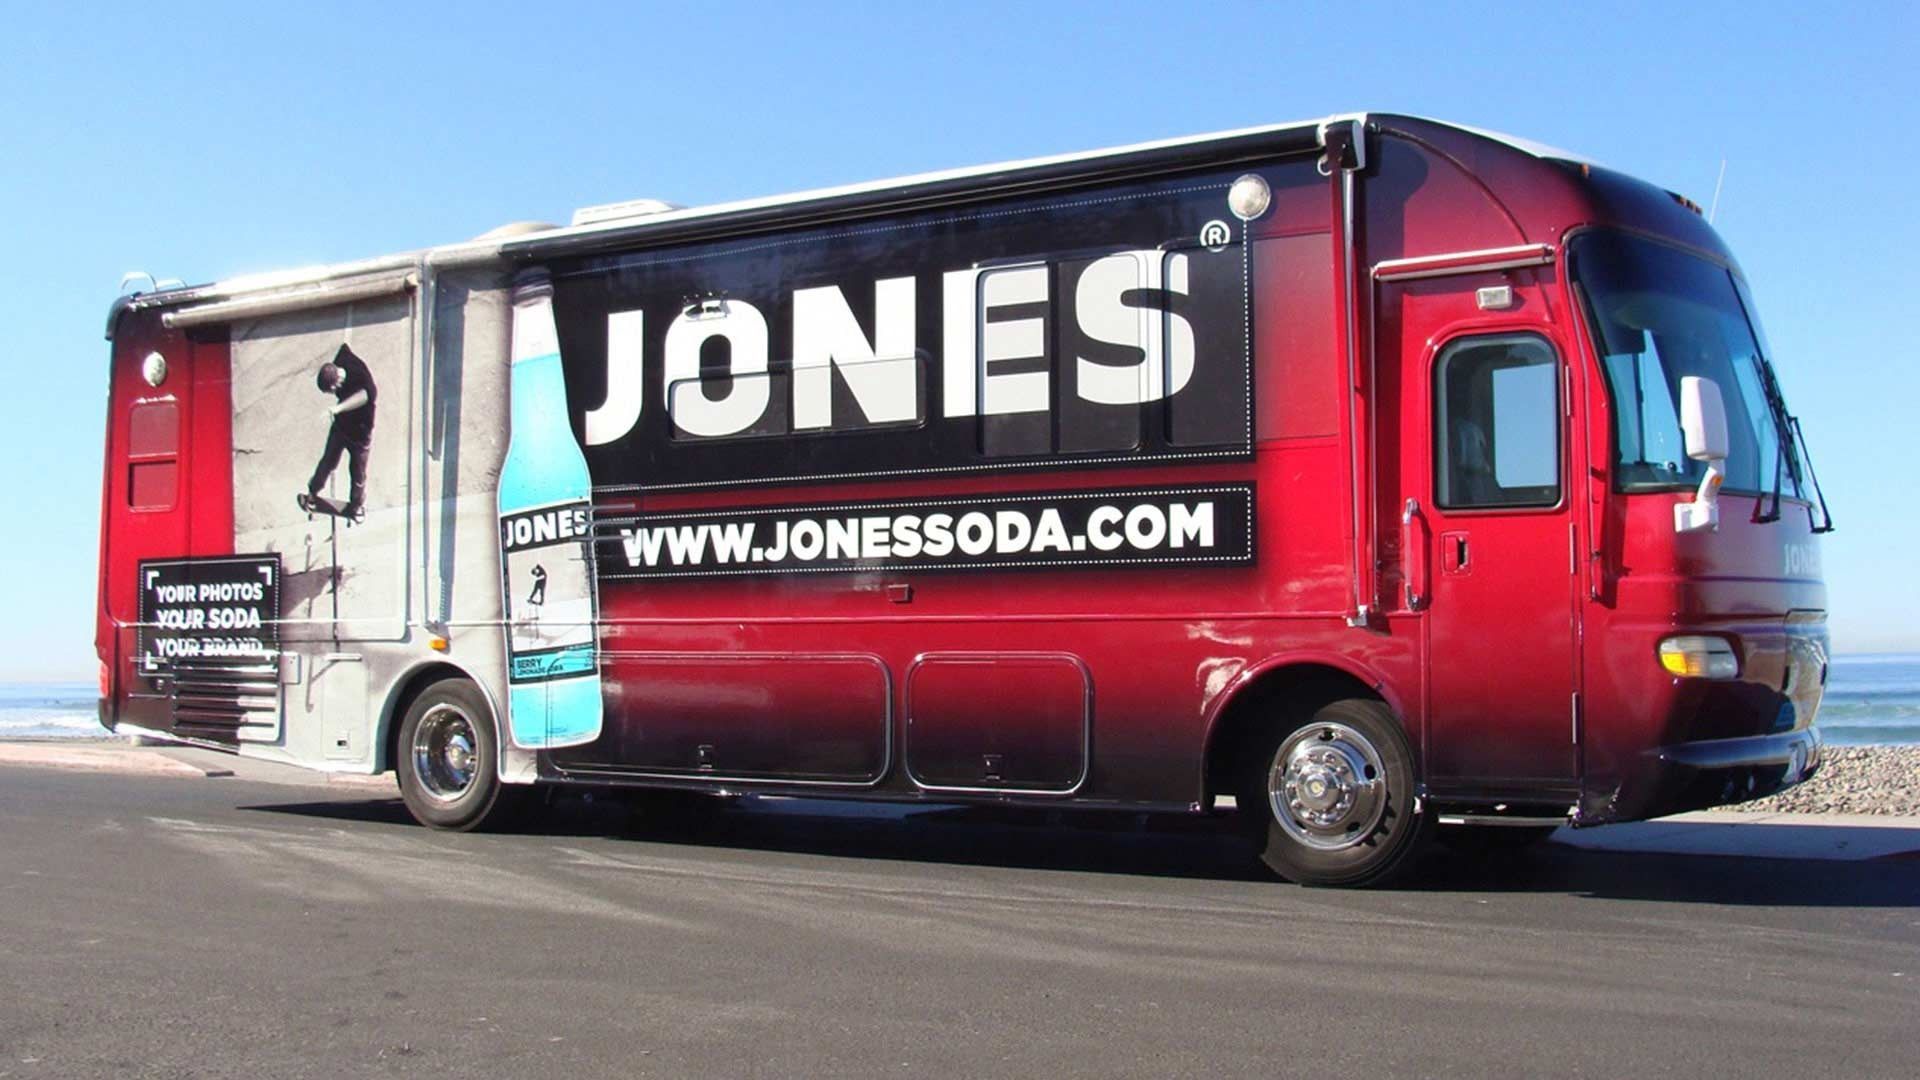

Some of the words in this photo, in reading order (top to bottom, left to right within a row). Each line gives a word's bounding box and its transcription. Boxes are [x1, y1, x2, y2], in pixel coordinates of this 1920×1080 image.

[585, 248, 1197, 447] JONES
[506, 509, 586, 548] JONES
[620, 502, 1214, 567] WWW.JONESSODA.COM
[156, 584, 197, 603] YOUR
[200, 582, 263, 602] PHOTOS
[156, 608, 204, 630] YOUR
[208, 606, 260, 629] SODA
[156, 637, 200, 656] YOUR
[202, 636, 263, 656] BRAND
